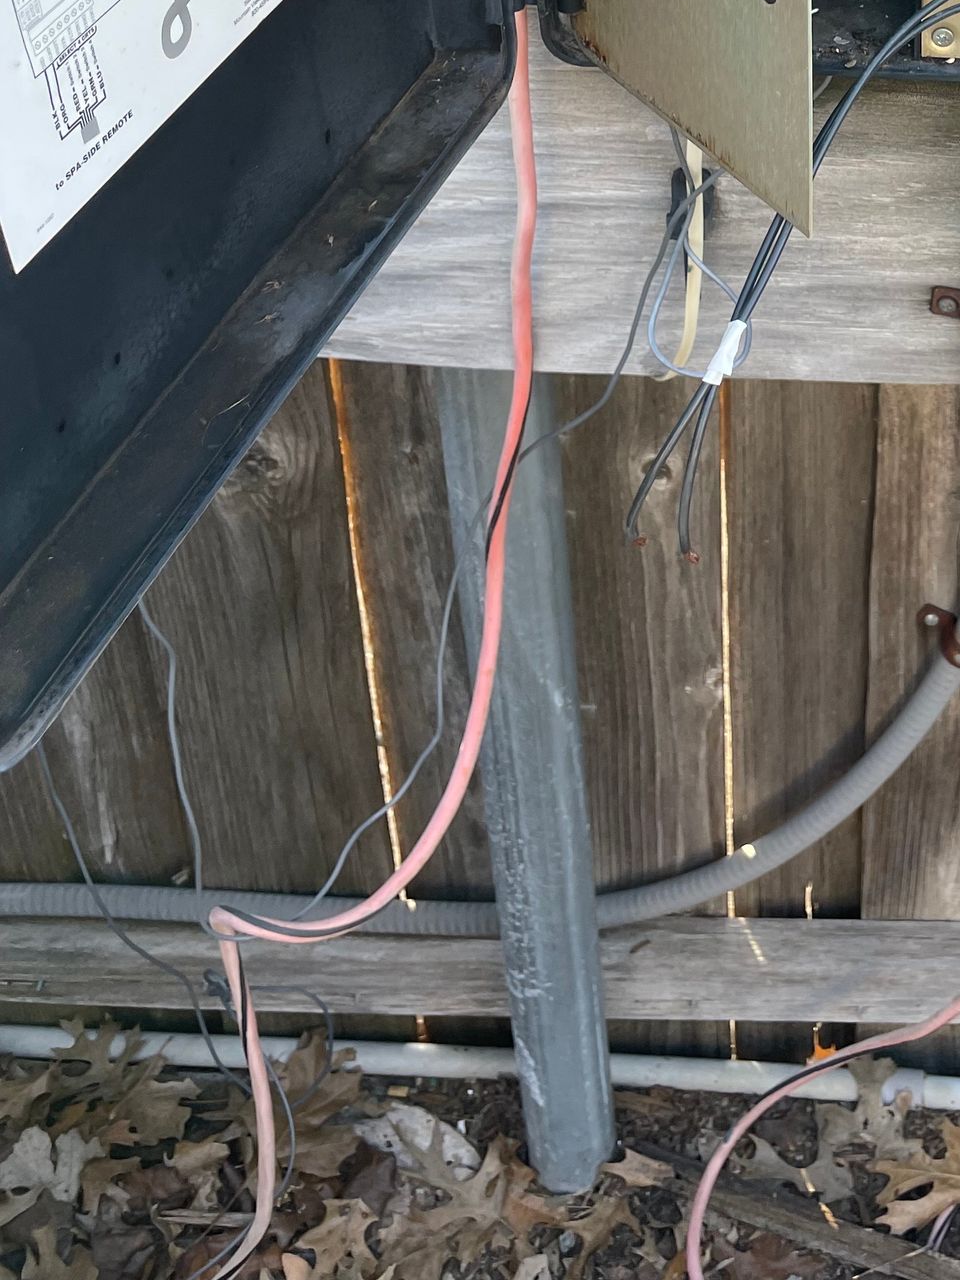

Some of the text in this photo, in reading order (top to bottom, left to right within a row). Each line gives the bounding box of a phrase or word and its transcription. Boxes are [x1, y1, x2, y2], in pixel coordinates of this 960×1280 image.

[56, 109, 134, 190] to SPA-SIDE REMOTE
